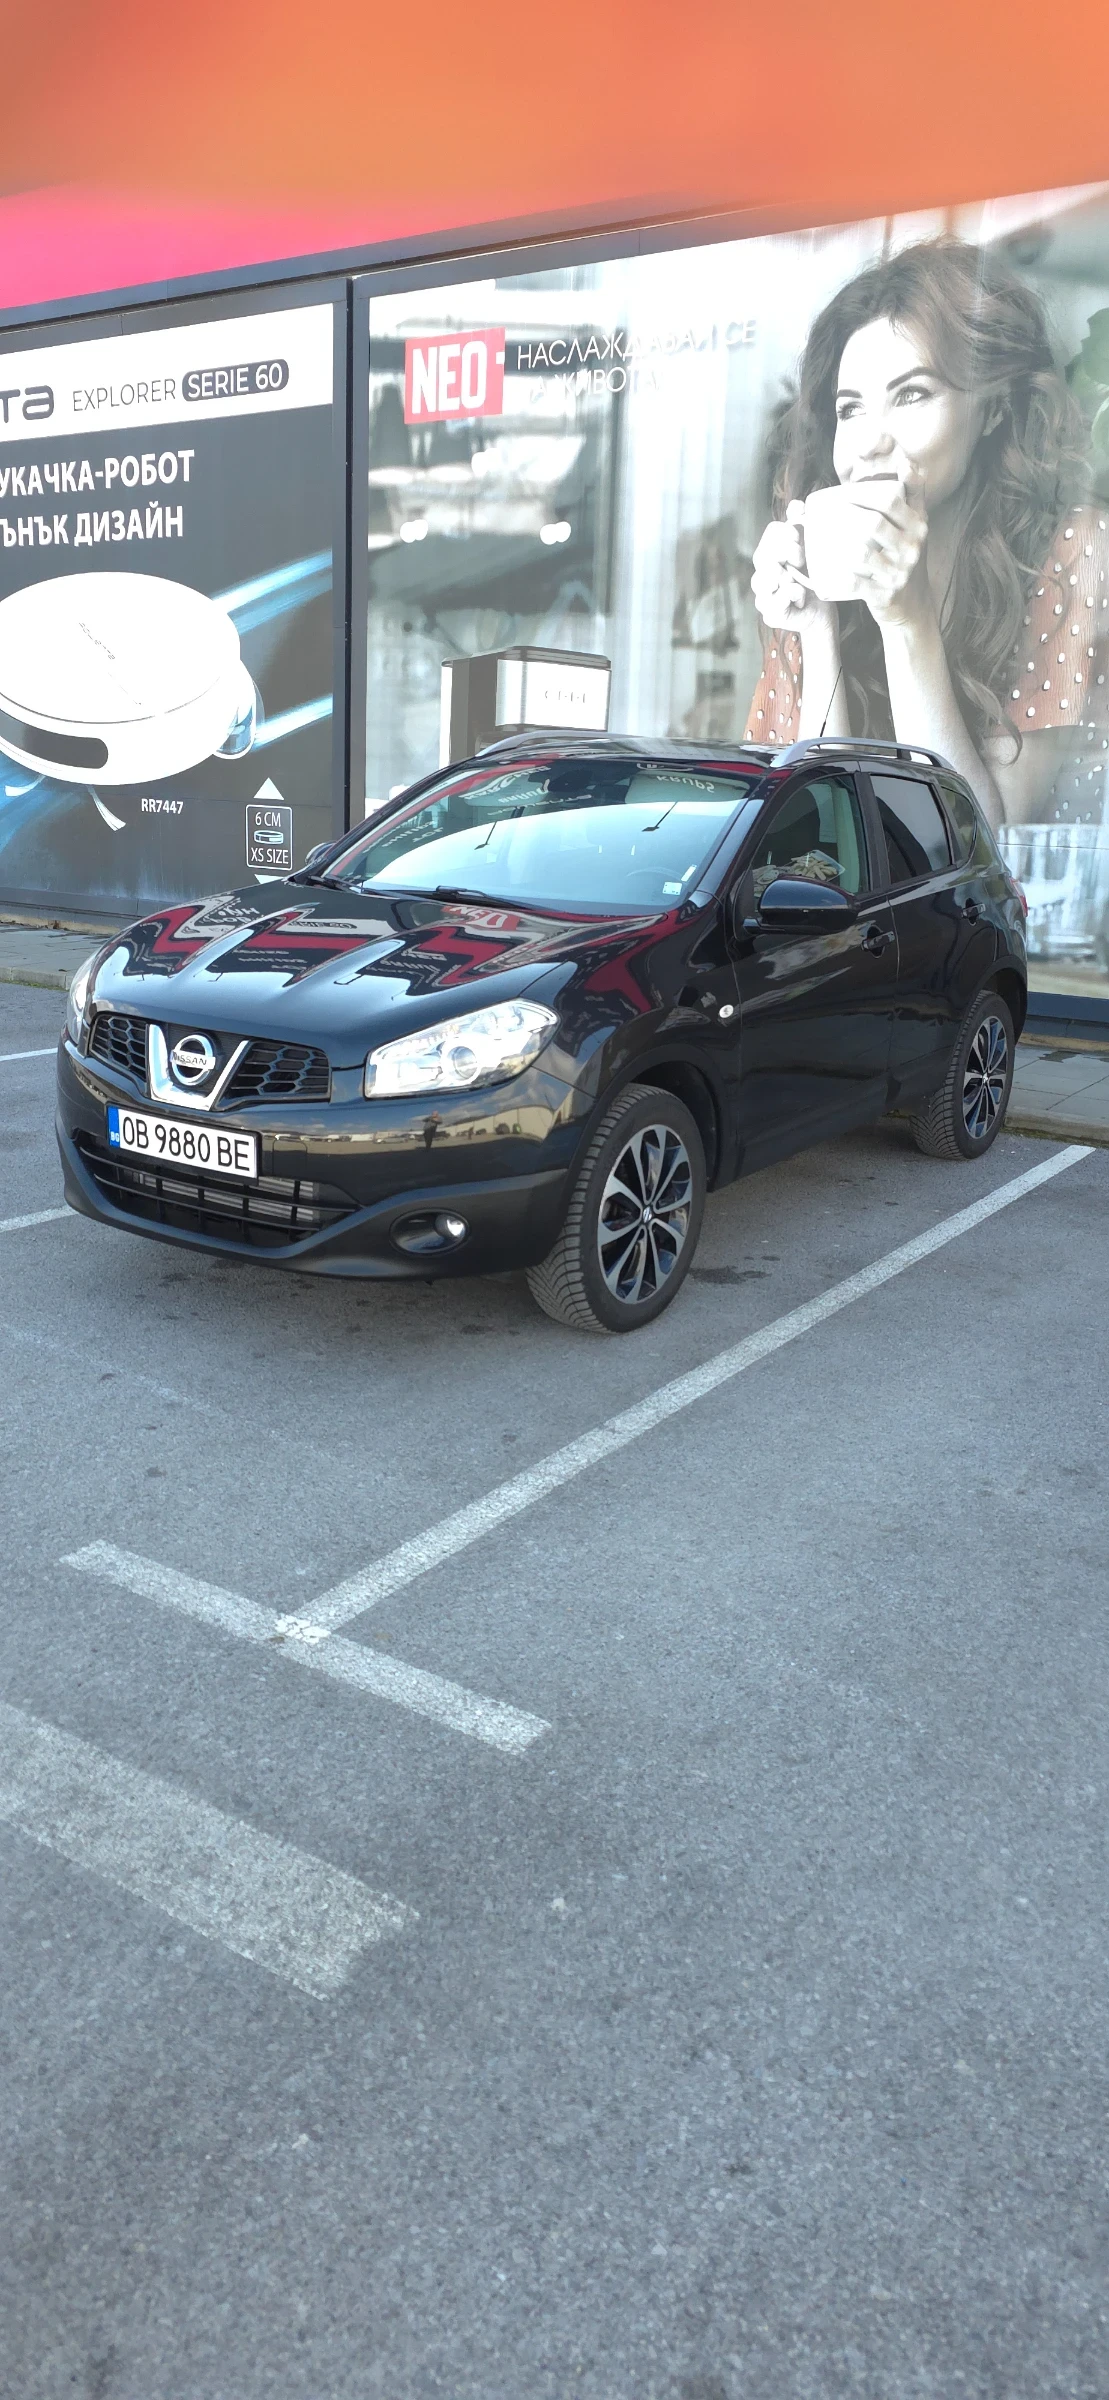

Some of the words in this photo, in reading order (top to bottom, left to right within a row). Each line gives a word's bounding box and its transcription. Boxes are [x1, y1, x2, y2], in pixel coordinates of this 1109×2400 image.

[411, 340, 487, 415] NEO
[72, 378, 177, 412] EXPLORER
[187, 366, 249, 398] SERIE
[255, 362, 283, 390] 60
[73, 500, 184, 548] ДИЗАЙН
[141, 798, 184, 814] RR7447
[255, 811, 262, 826] 6
[264, 811, 282, 827] CM
[250, 847, 264, 863] XS
[266, 849, 289, 865] SIZE
[172, 1050, 208, 1066] NISSAN
[110, 1130, 120, 1143] BG
[154, 1123, 211, 1163] 9880
[217, 1136, 250, 1172] BE
